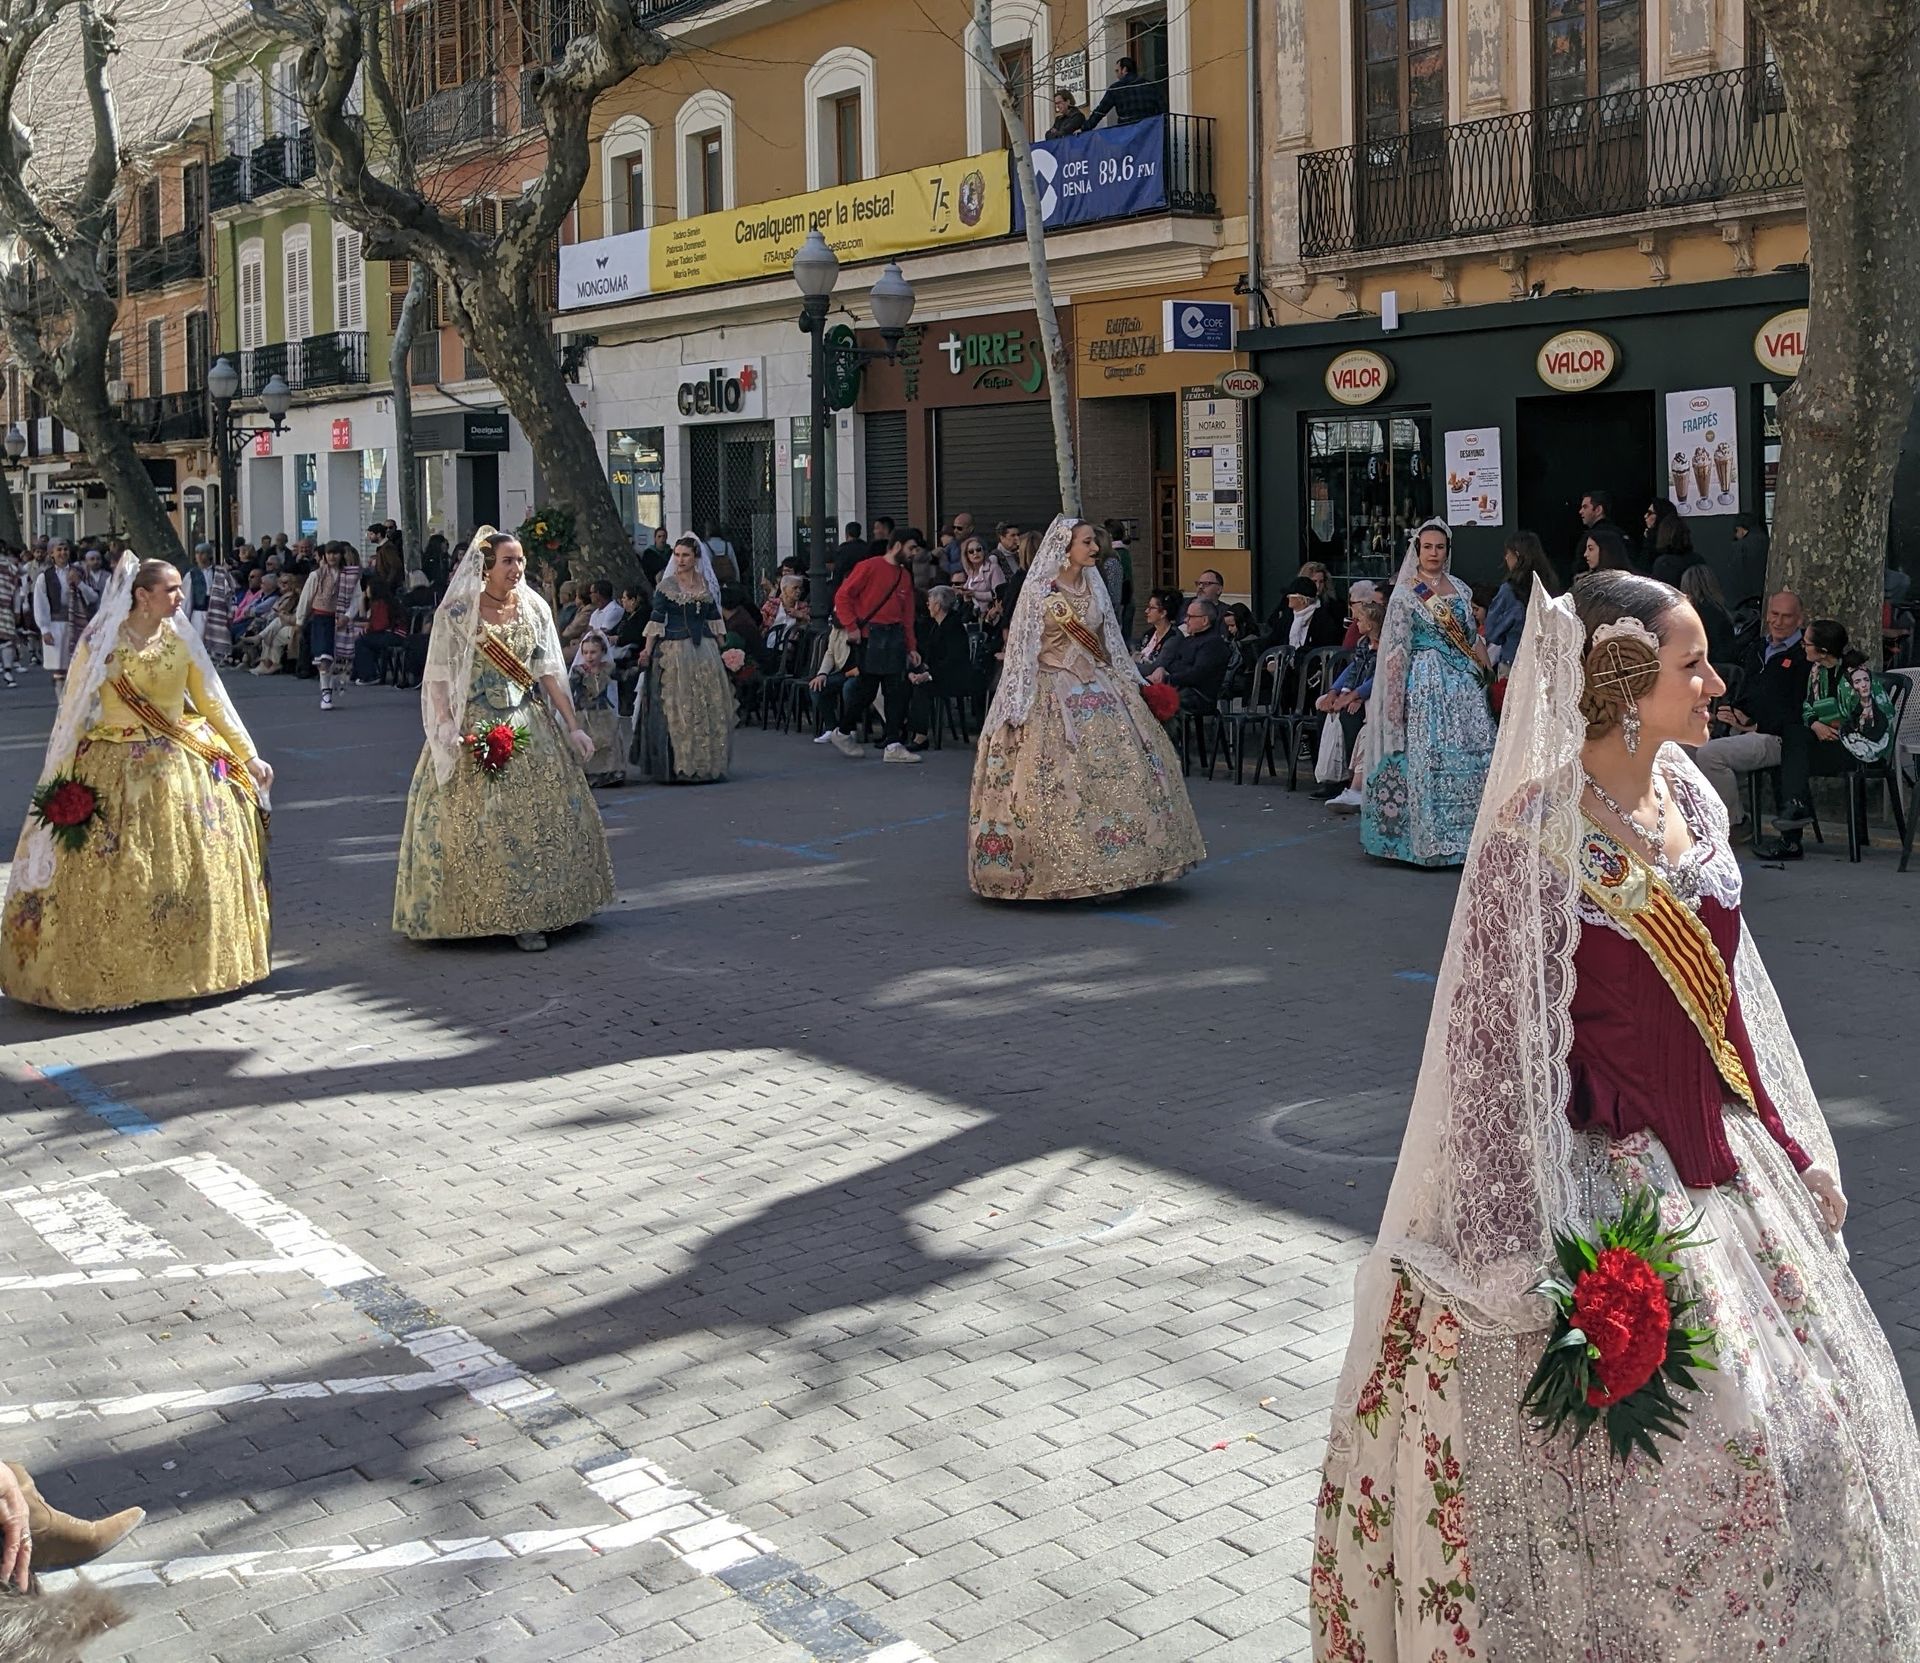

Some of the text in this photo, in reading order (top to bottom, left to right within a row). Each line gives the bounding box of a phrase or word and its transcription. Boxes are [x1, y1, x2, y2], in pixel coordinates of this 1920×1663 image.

[1062, 155, 1155, 185] COPE 89.6 FM
[1063, 179, 1092, 197] DENIA
[735, 189, 895, 244] Cavalquem per la festa!
[763, 238, 863, 264] #75AnysOe oeste.com
[577, 274, 629, 299] MONGOMAR
[1203, 318, 1223, 328] COPE
[1764, 332, 1804, 357] VAL
[1545, 349, 1605, 374] VALOR
[1225, 379, 1259, 390] VALOR
[1332, 367, 1381, 390] VALOR
[678, 367, 745, 416] celio
[1691, 400, 1708, 408] VALOR
[1198, 420, 1226, 430] NOTARIO
[1683, 411, 1718, 434] FRAPPÉS
